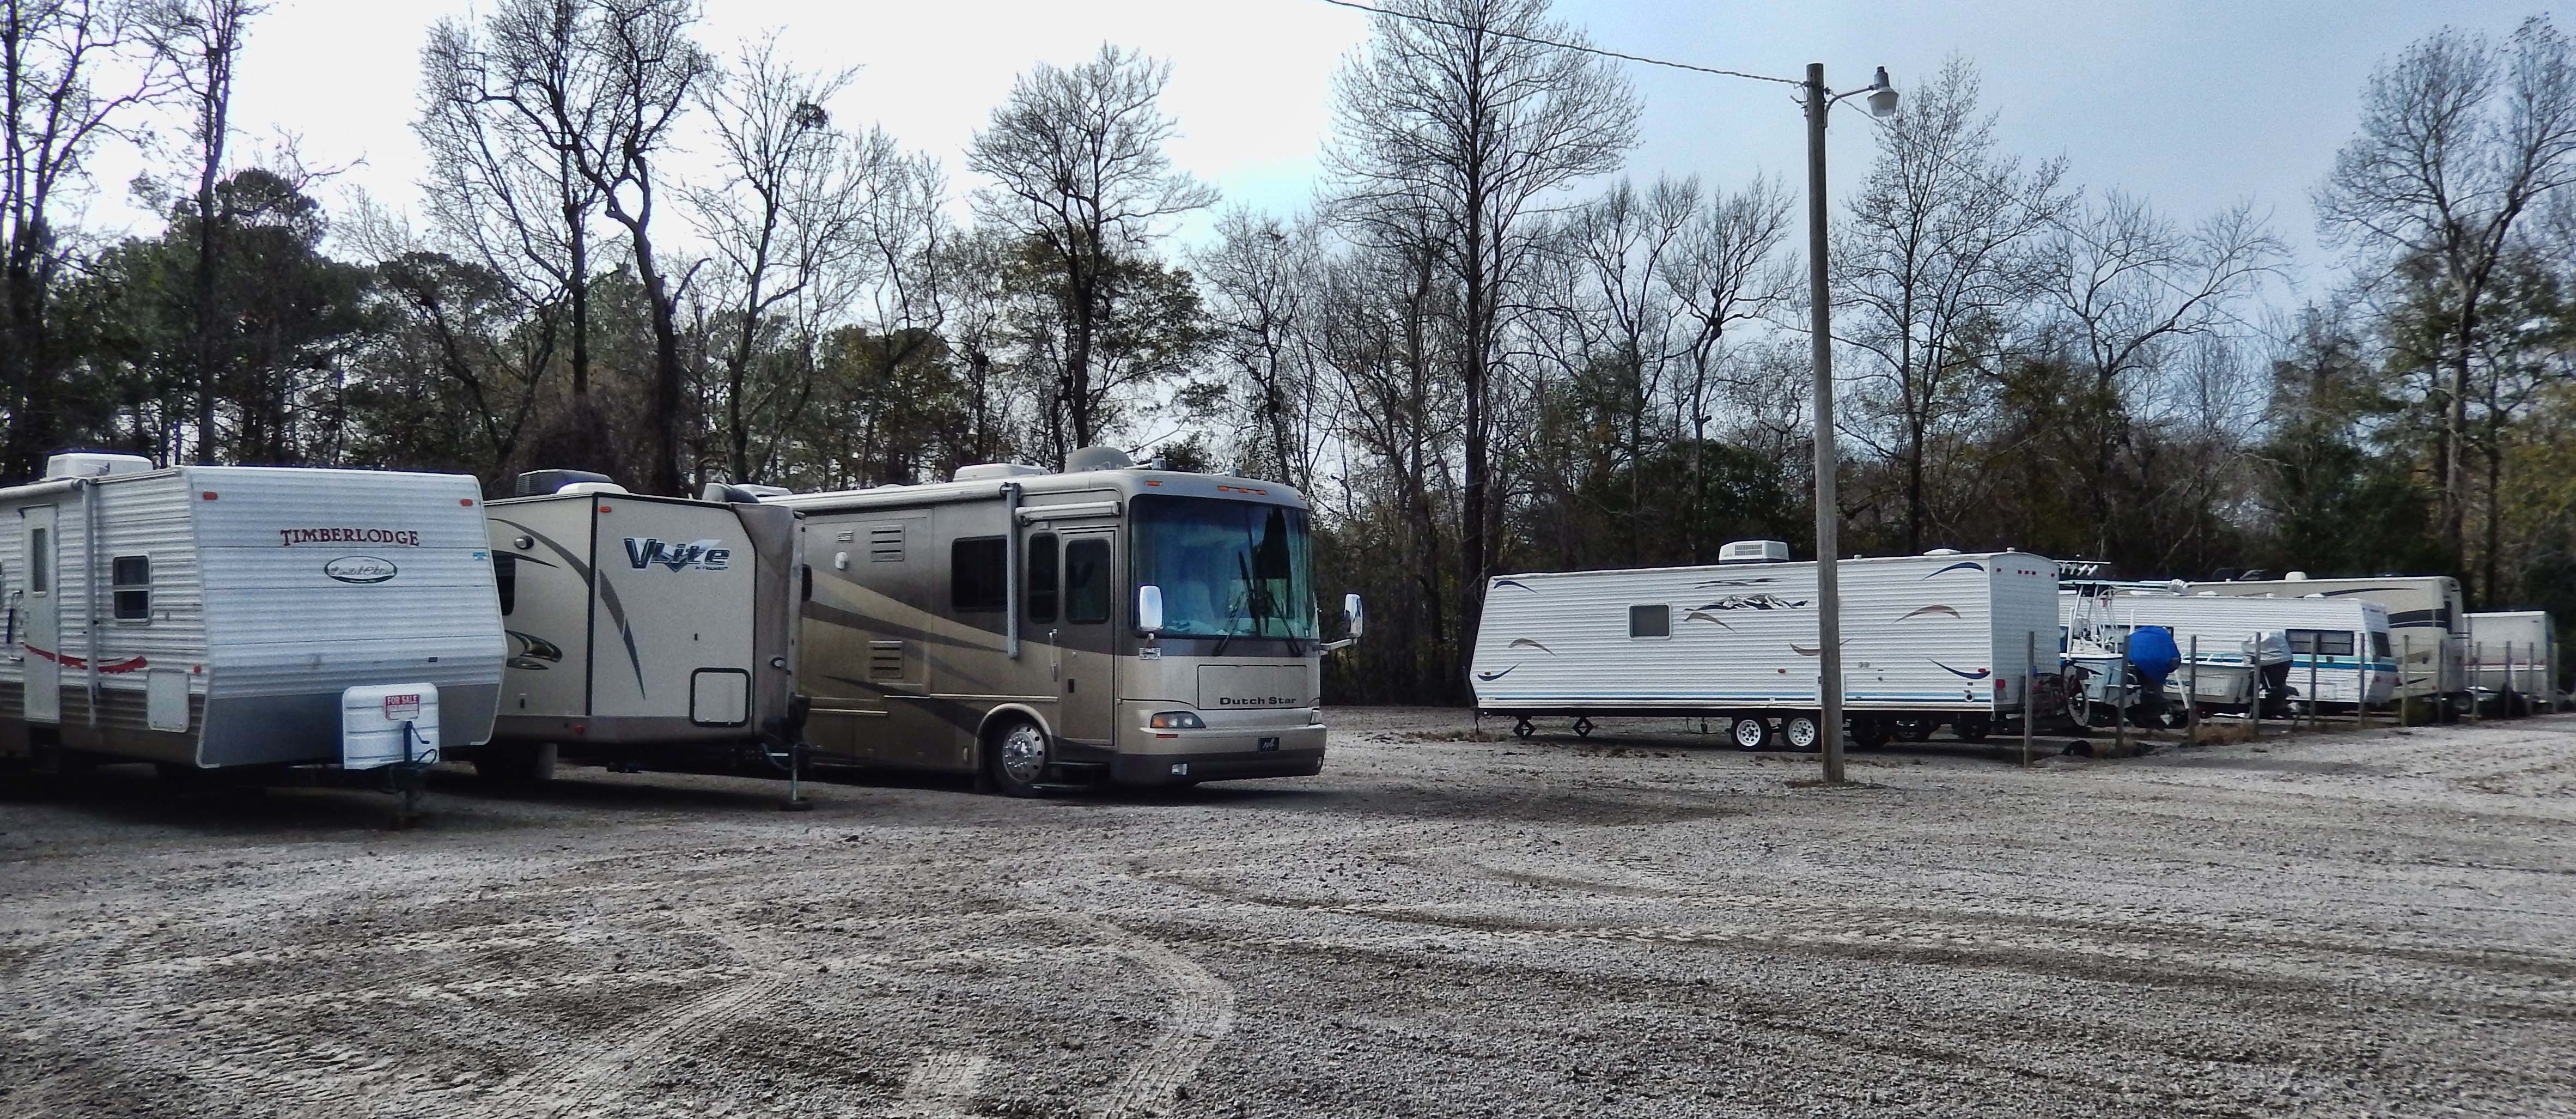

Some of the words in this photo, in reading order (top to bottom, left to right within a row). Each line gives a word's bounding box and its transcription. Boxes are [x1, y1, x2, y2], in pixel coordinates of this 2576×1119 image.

[280, 528, 419, 546] TIMBERLODGE
[387, 696, 400, 704] FOR
[402, 695, 418, 703] SALE
